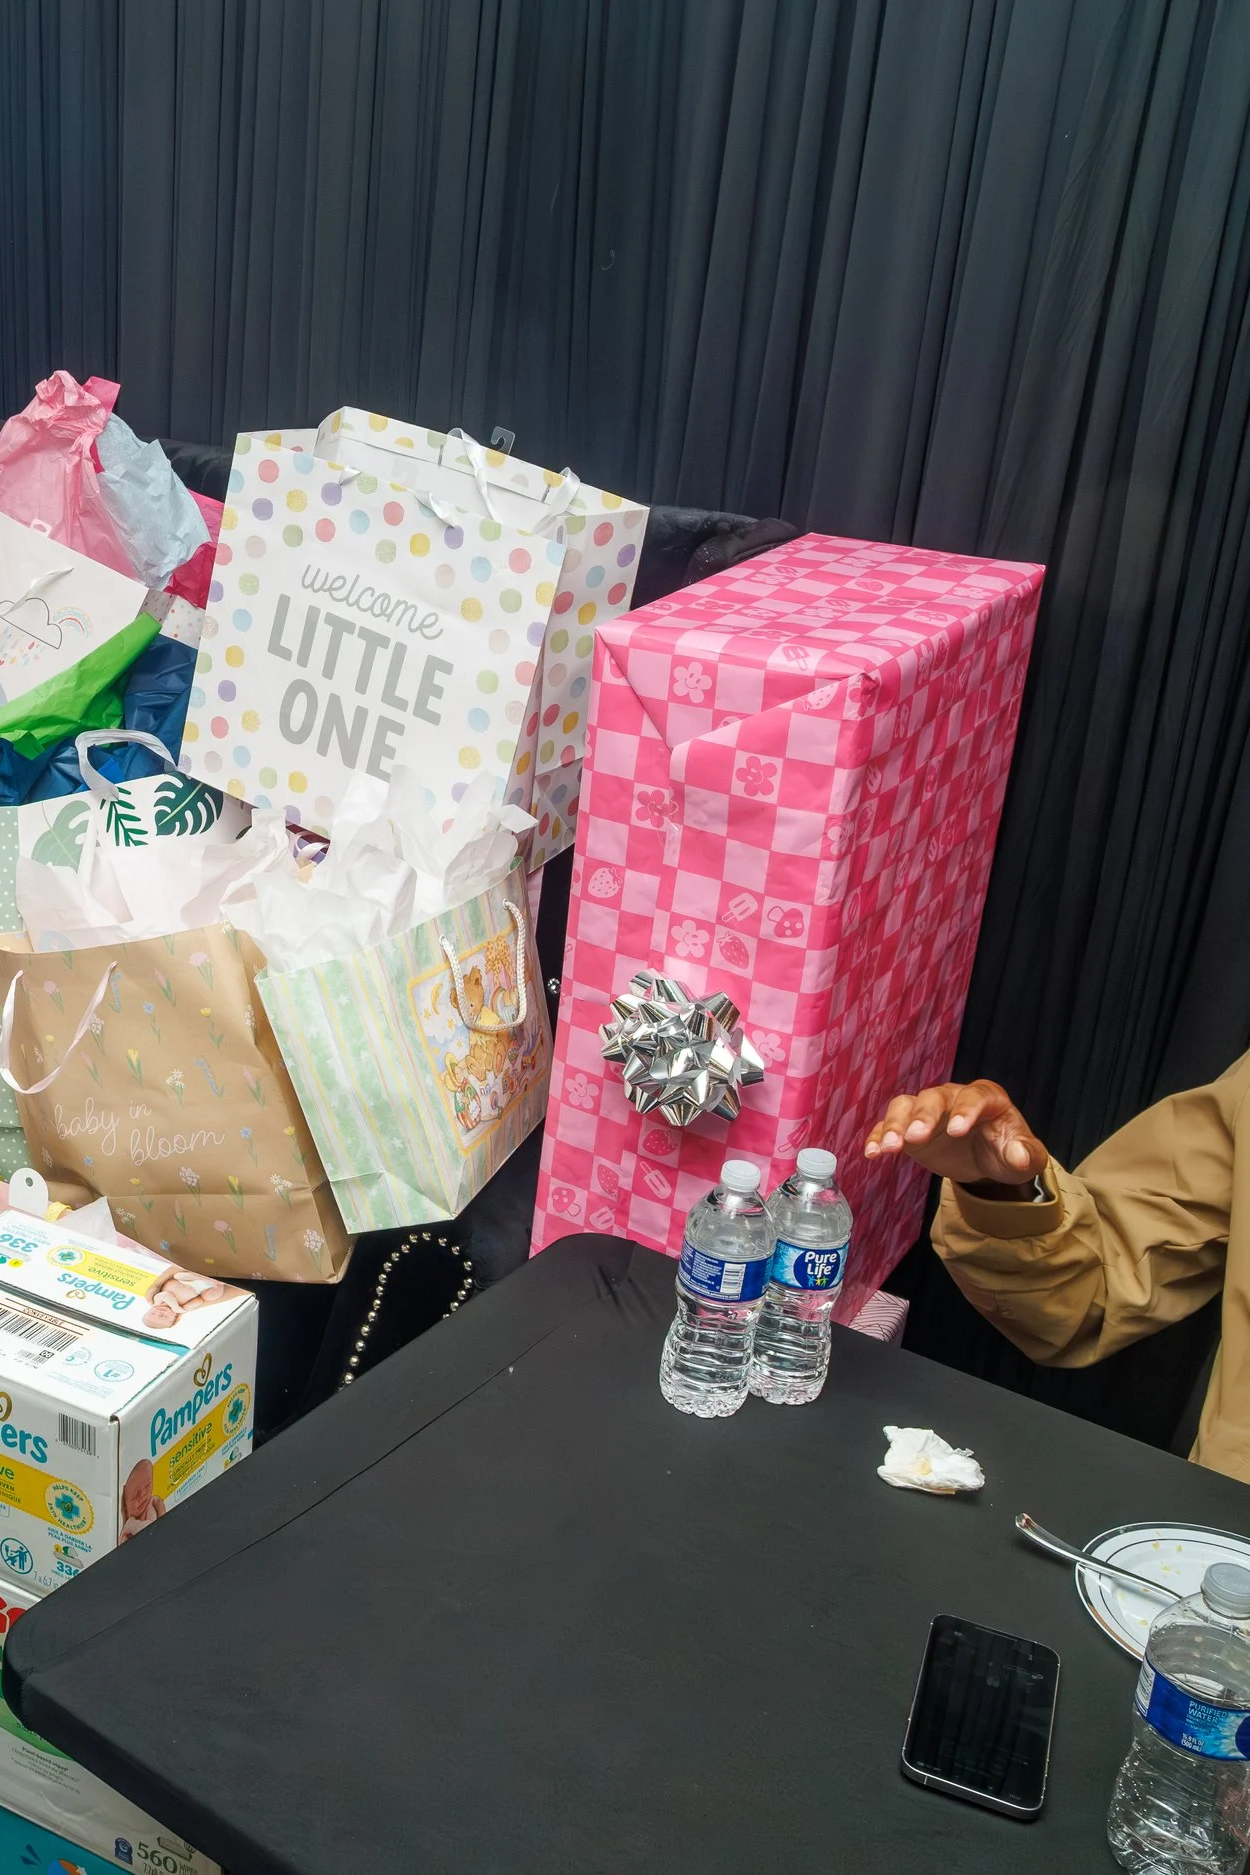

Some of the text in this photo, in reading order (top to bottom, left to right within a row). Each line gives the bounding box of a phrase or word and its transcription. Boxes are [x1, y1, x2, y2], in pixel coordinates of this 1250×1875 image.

[301, 563, 444, 640] welcome
[267, 593, 454, 726] LITTLE
[279, 678, 406, 783] ONE
[54, 1096, 152, 1156] baby in
[130, 1126, 226, 1166] bloom
[87, 1264, 138, 1287] sensitive
[804, 1251, 838, 1264] Pure
[806, 1263, 832, 1278] Life
[56, 1272, 136, 1310] Pampers
[22, 1307, 64, 1326] CONVEYABLE
[150, 1362, 233, 1458] Pampers
[169, 1421, 213, 1469] sensitive
[1188, 1707, 1218, 1724] WATER
[1189, 1700, 1228, 1718] PURIFIED
[136, 1841, 178, 1874] 560
